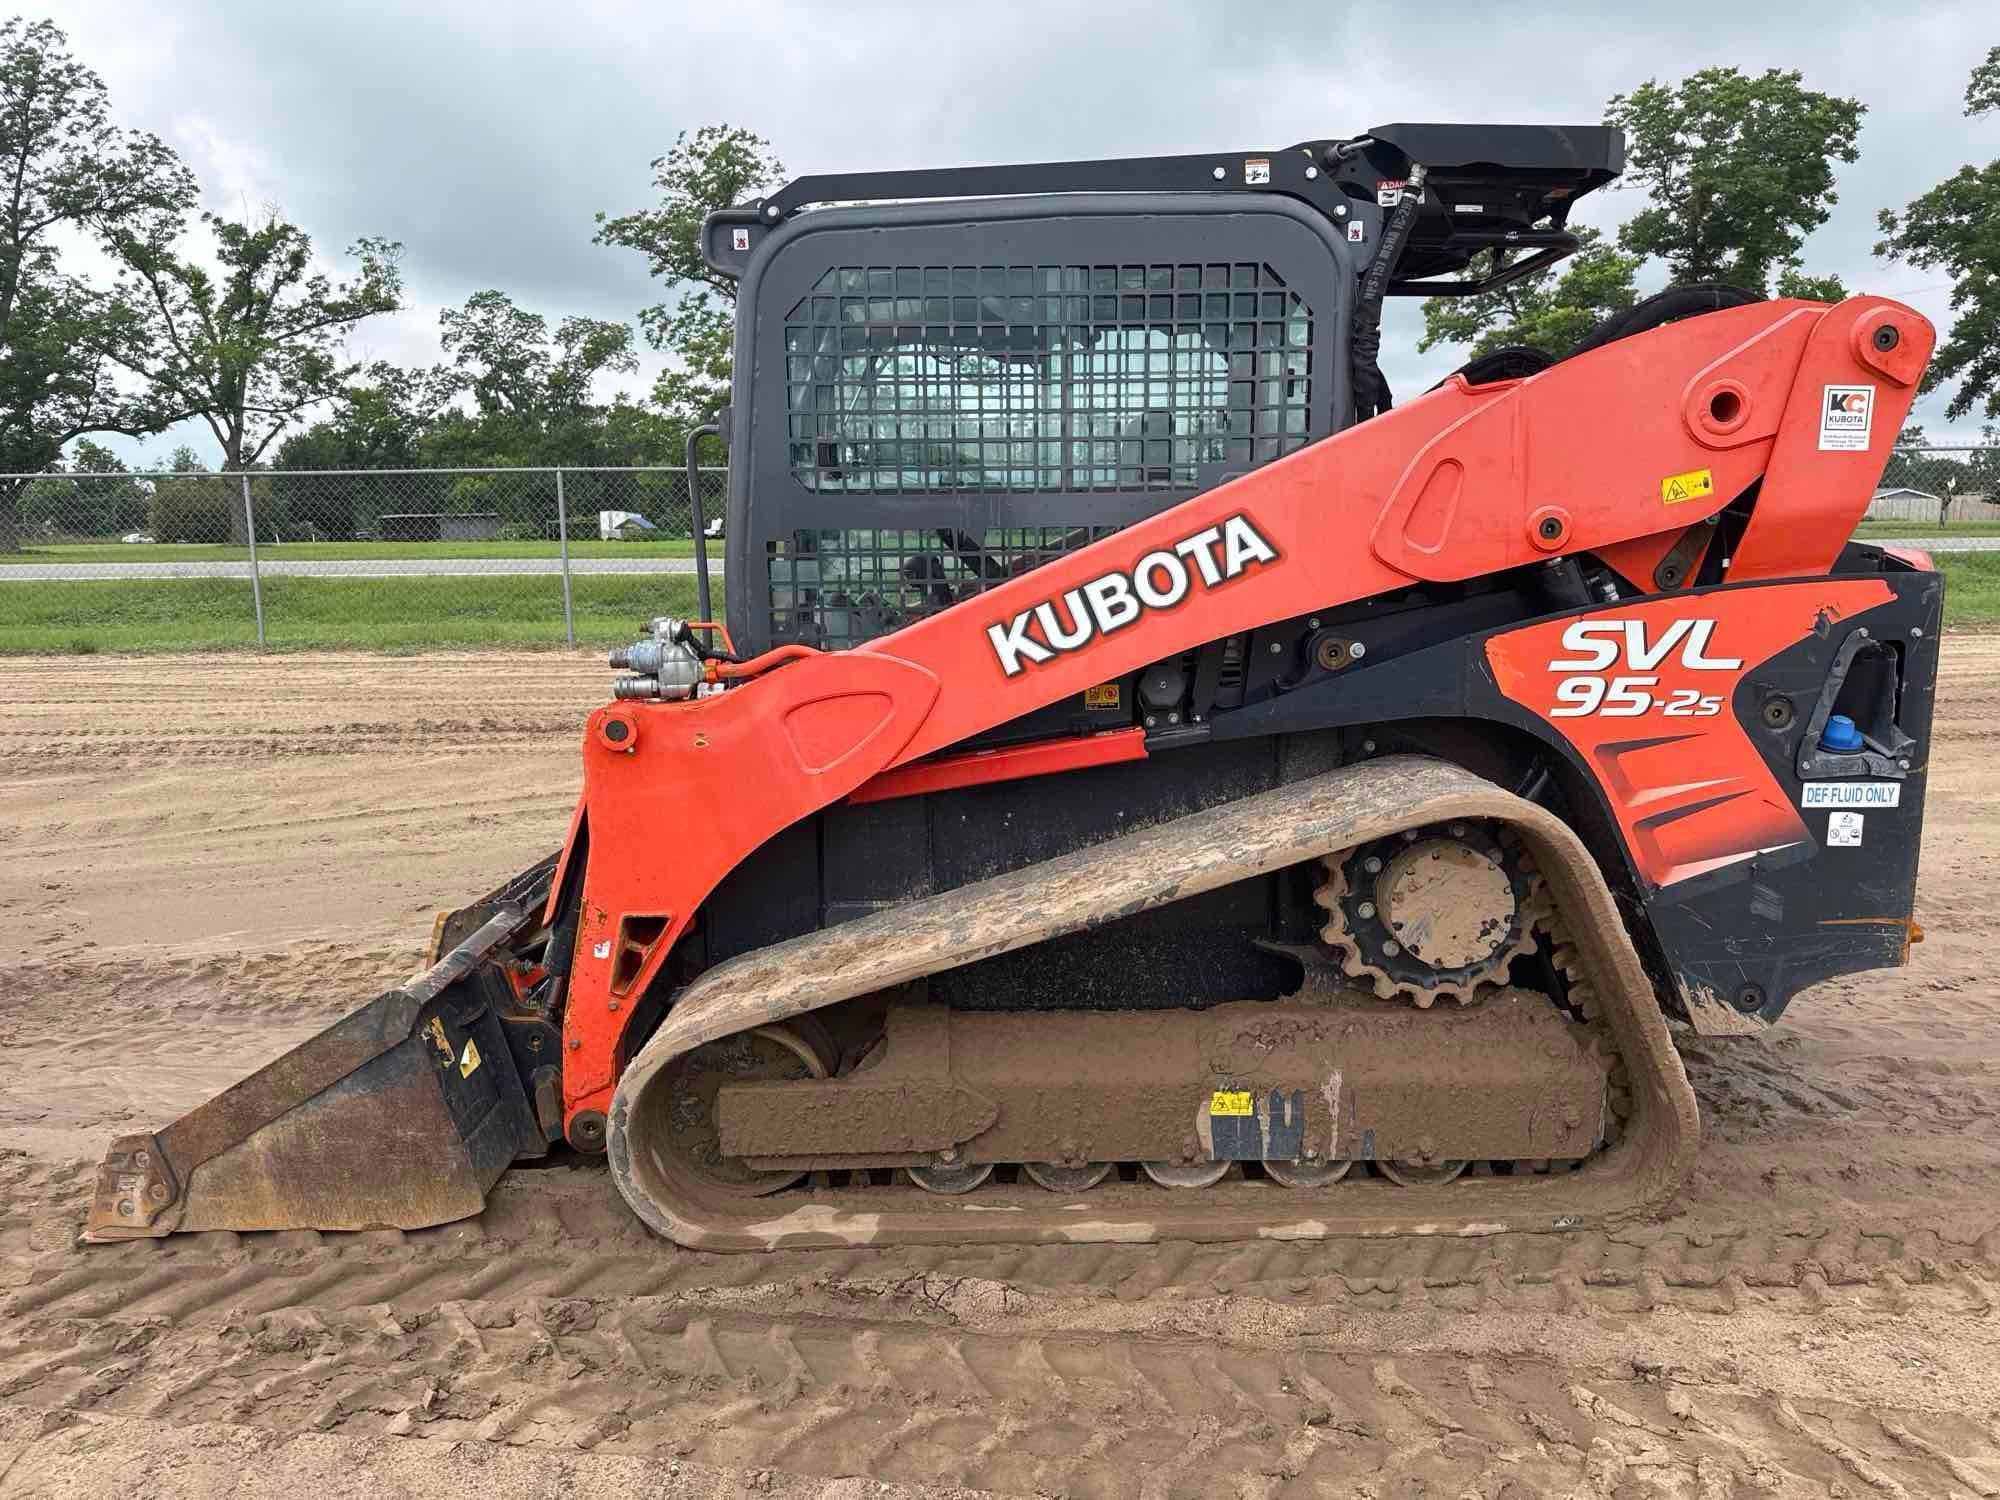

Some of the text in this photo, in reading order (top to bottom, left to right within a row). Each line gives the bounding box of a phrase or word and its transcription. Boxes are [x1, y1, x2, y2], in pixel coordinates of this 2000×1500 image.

[1830, 393, 1866, 413] KC
[1828, 415, 1864, 423] KUBOTA
[986, 514, 1278, 677] KUBOTA
[1548, 619, 1743, 671] SVL
[1806, 787, 1895, 803] DEF FLUID ONLY
